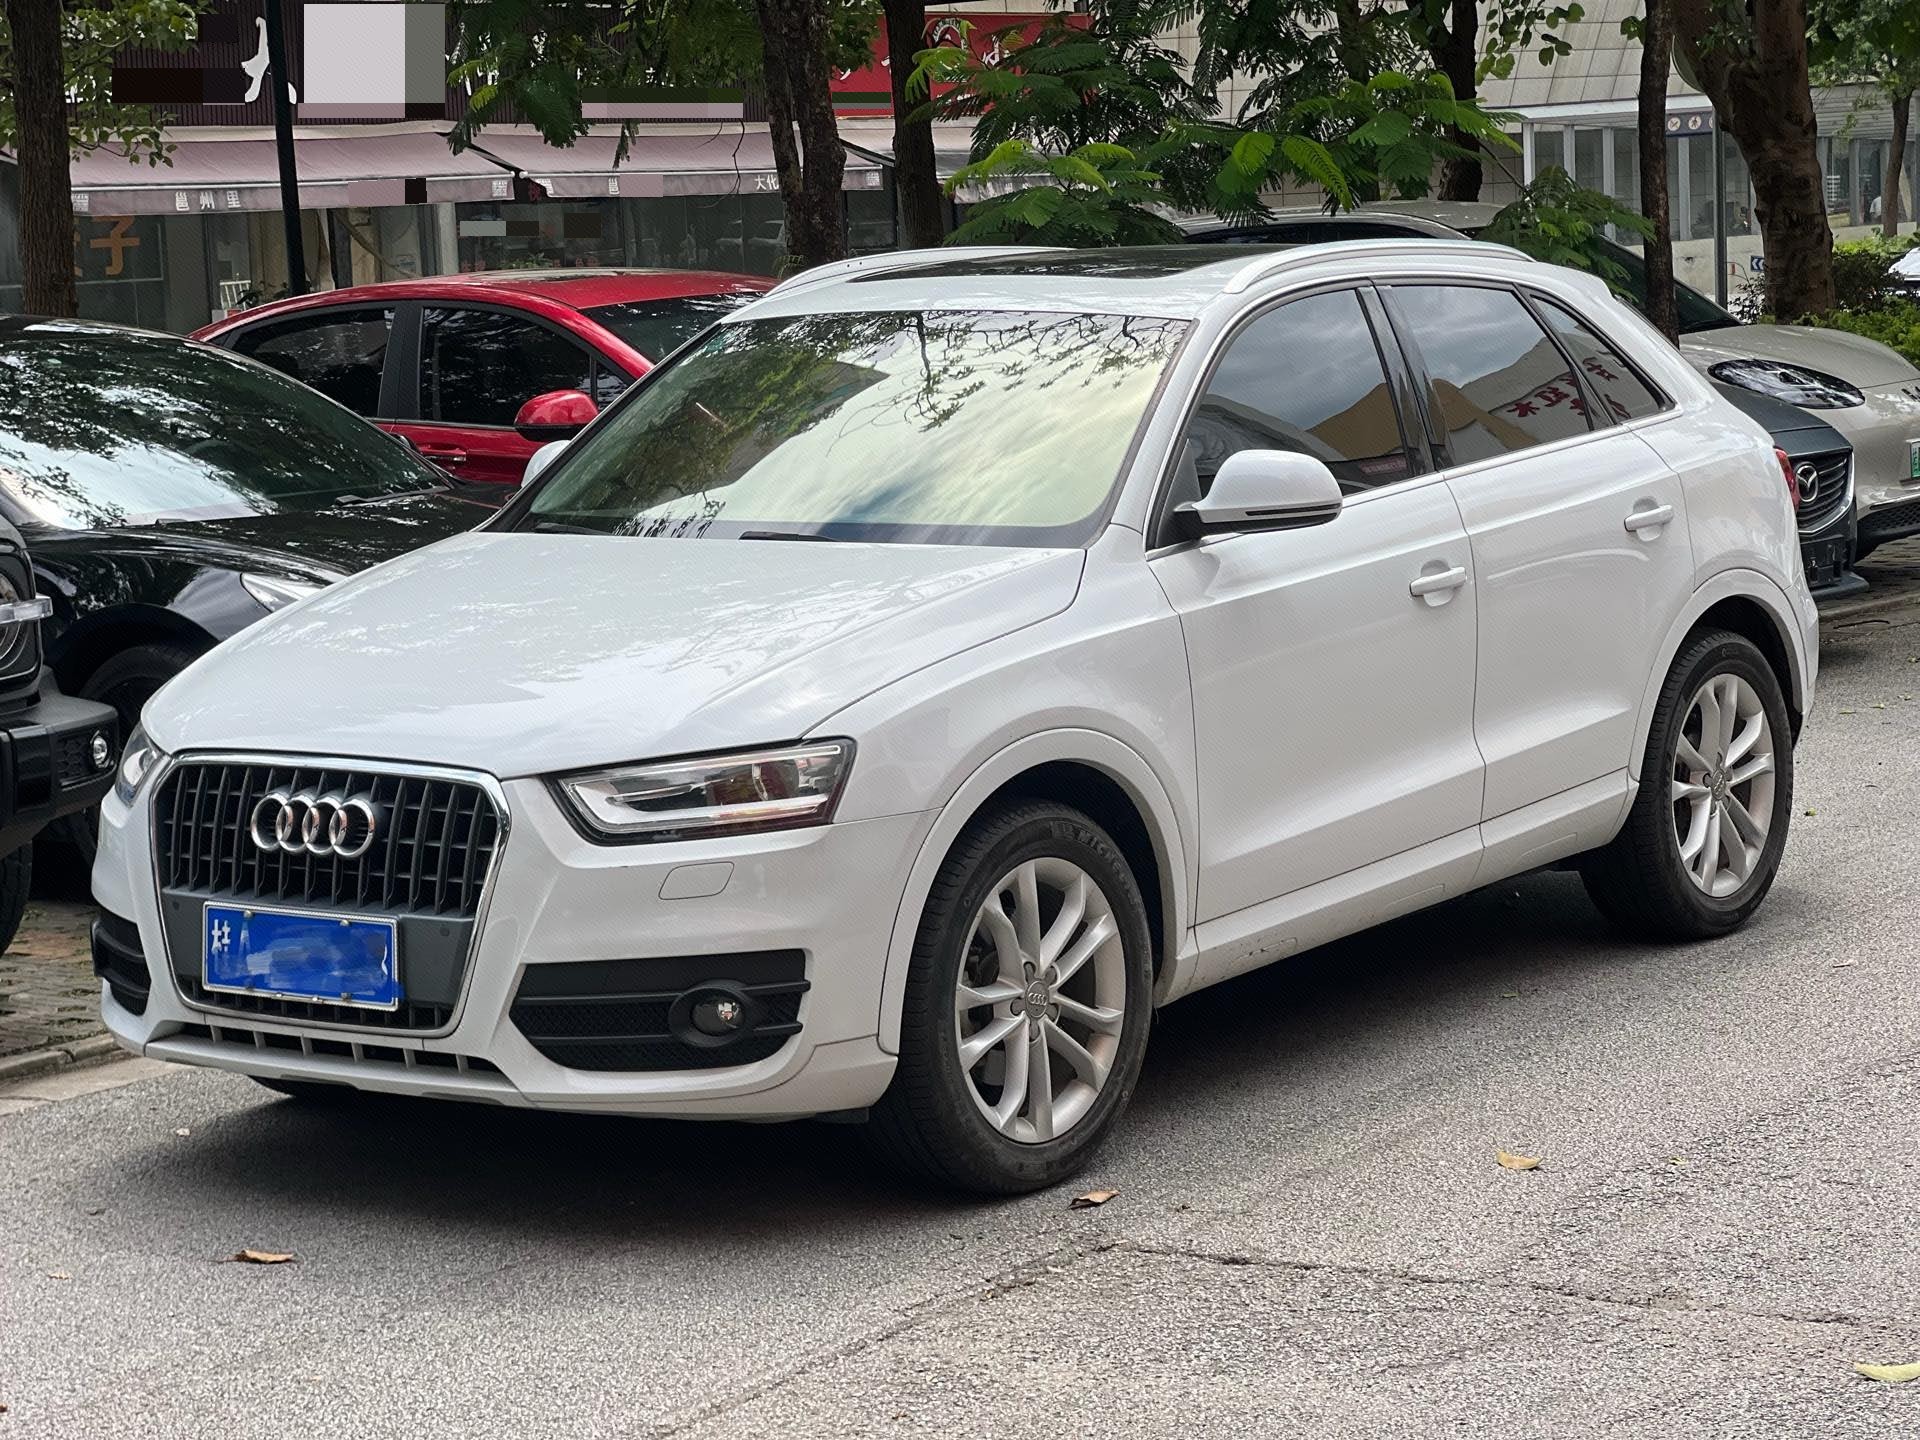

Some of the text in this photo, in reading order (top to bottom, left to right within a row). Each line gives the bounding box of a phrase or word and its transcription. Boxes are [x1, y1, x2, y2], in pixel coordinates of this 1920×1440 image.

[174, 190, 241, 211] 邕州里
[74, 214, 140, 276] 子
